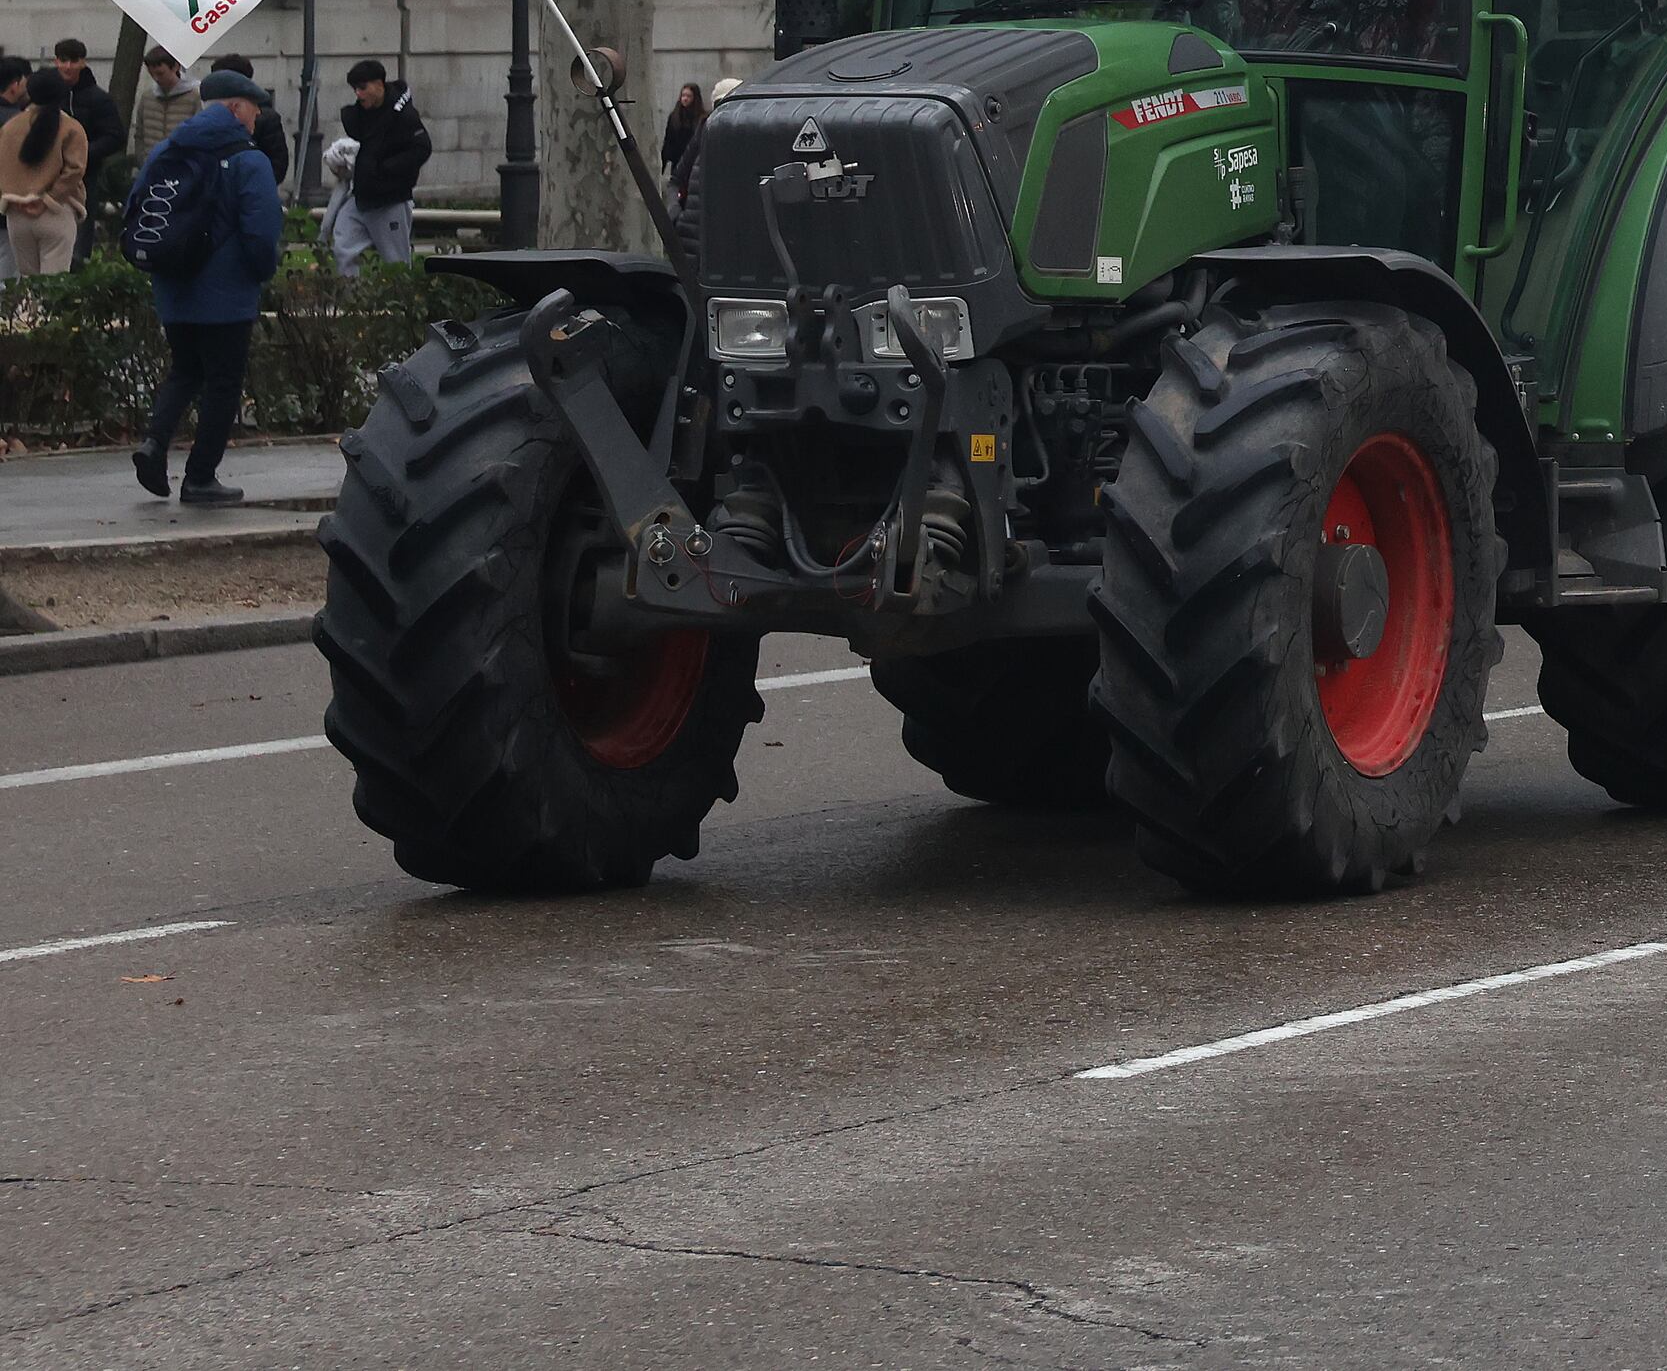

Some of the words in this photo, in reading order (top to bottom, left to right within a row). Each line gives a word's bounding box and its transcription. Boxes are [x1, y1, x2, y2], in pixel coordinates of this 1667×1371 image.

[1131, 88, 1185, 124] FENDT
[1213, 91, 1228, 105] 211
[1228, 145, 1258, 173] Sapesa
